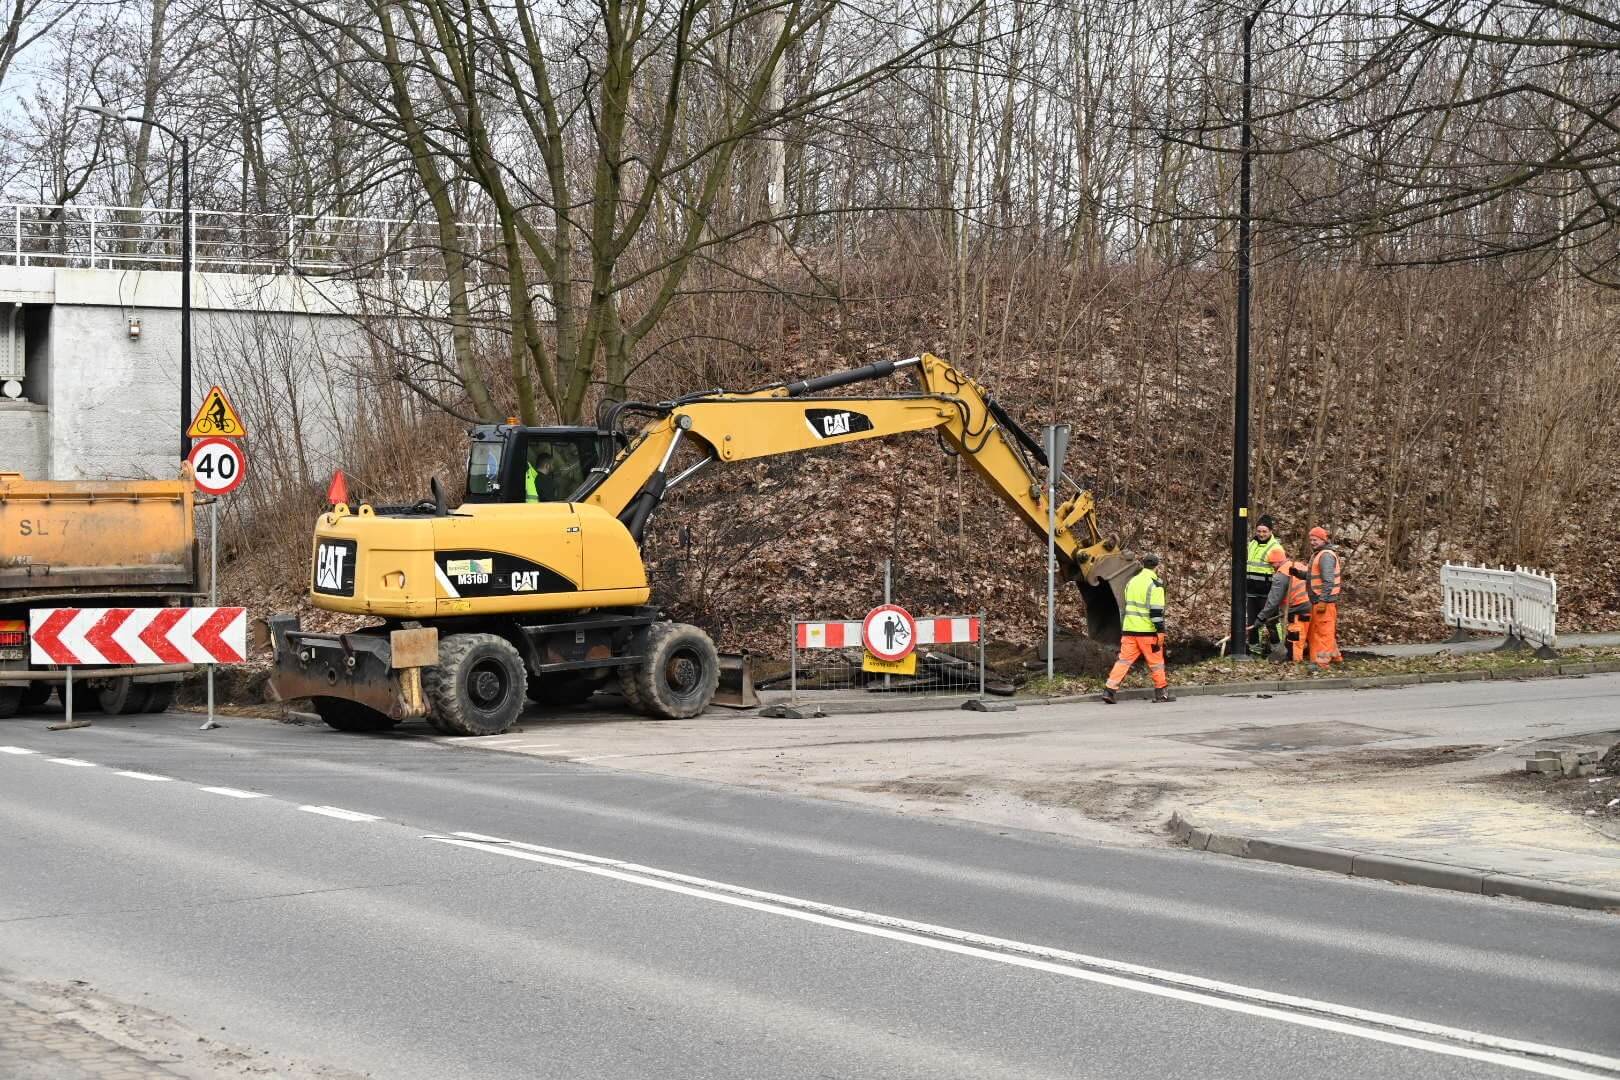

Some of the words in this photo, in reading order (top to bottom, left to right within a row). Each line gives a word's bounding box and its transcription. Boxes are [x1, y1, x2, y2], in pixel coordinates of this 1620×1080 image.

[823, 412, 850, 436] CAT
[196, 453, 235, 479] 40
[317, 543, 347, 590] CAT
[458, 573, 489, 585] M316D
[511, 571, 540, 592] CAT
